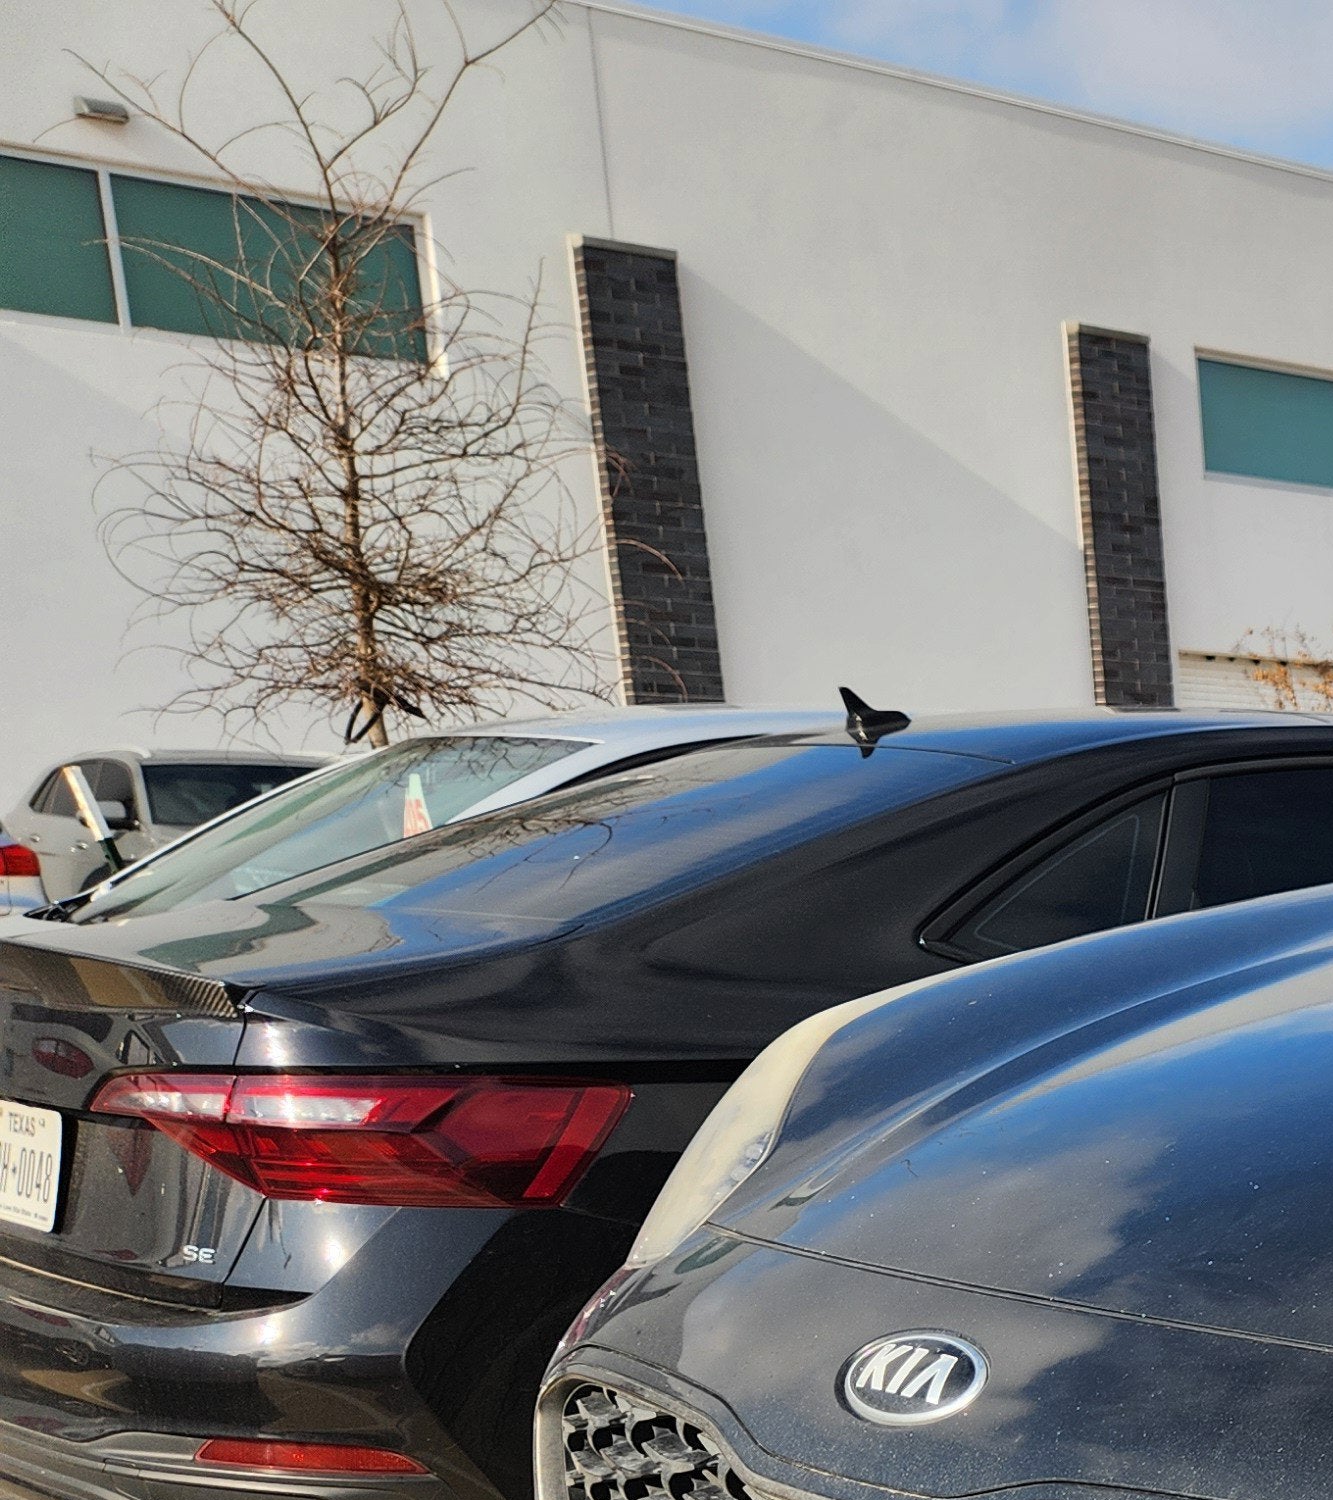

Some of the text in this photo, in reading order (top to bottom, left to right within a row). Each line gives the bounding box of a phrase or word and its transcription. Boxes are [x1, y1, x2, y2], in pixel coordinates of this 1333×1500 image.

[9, 1112, 36, 1137] TEXAS
[182, 1244, 217, 1266] SE
[855, 1343, 959, 1405] KIA
